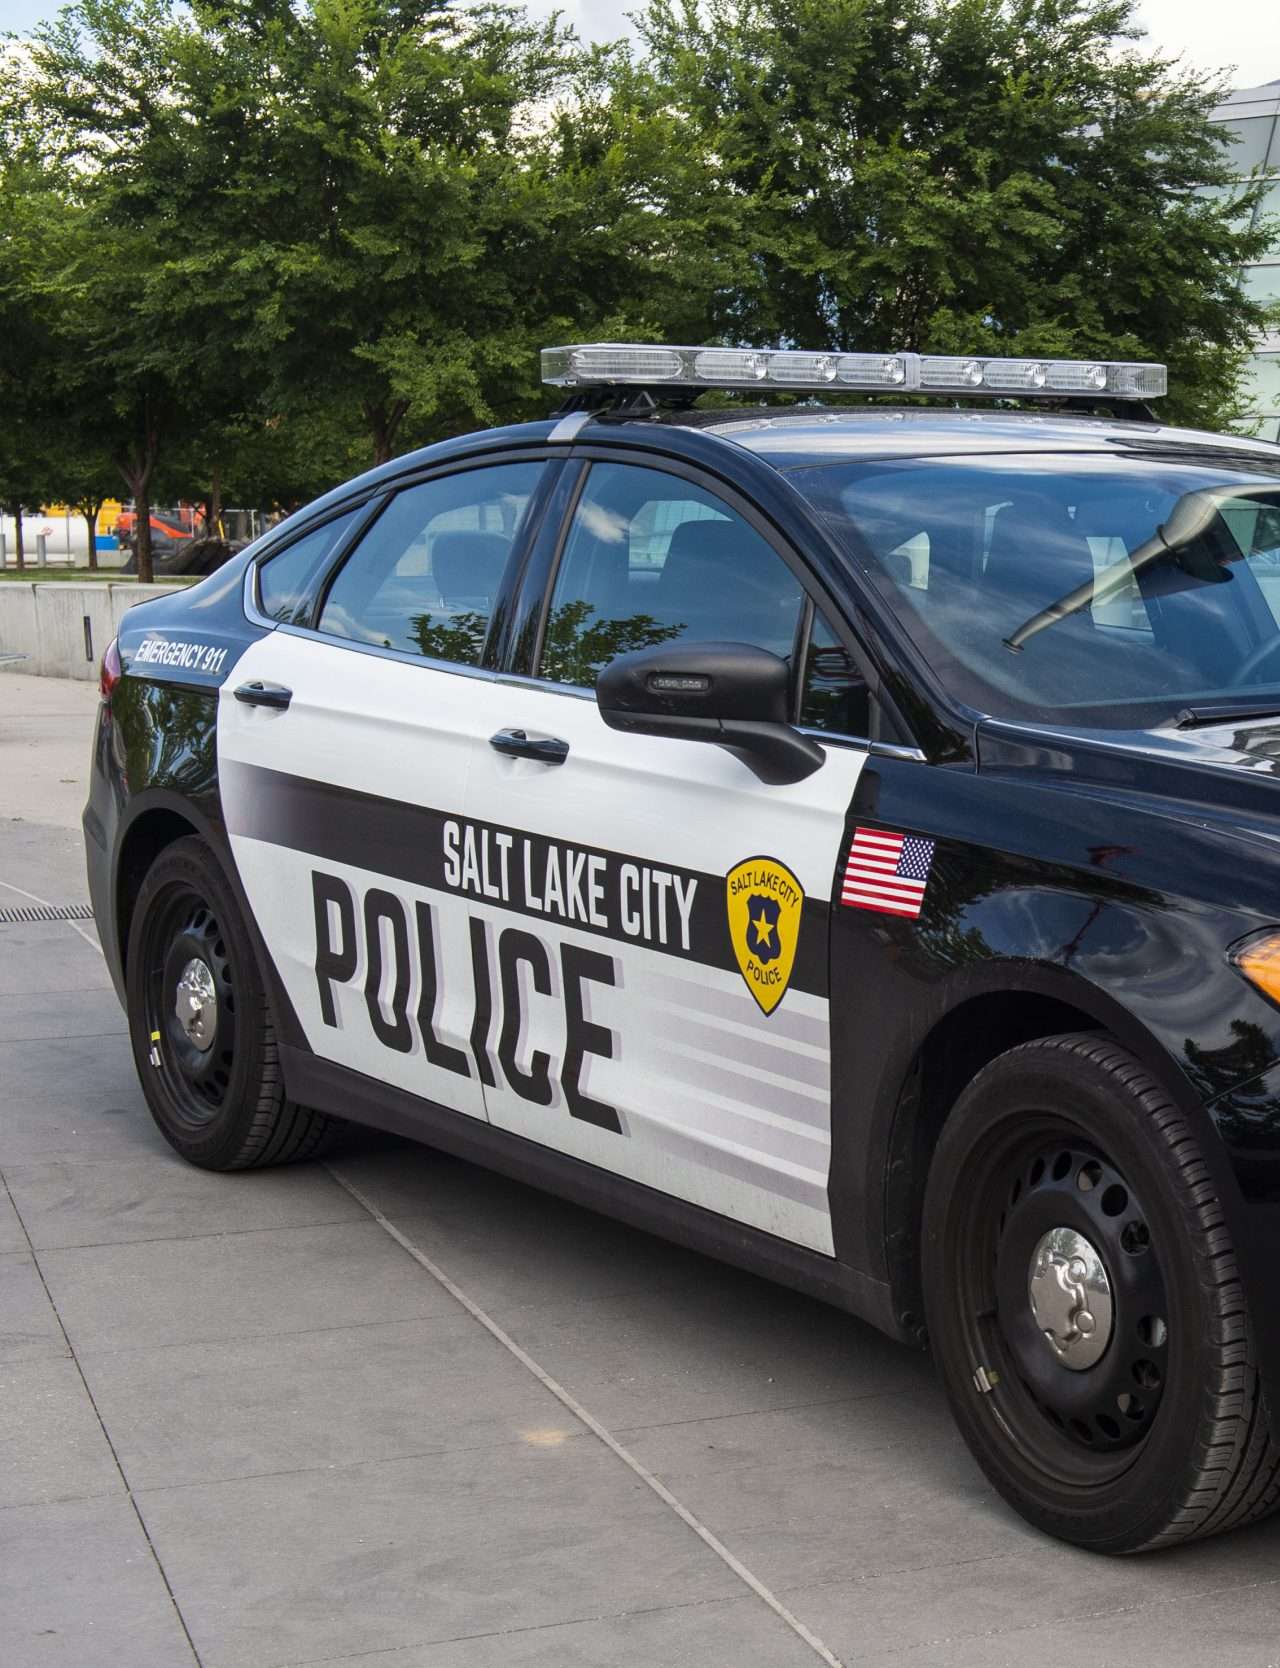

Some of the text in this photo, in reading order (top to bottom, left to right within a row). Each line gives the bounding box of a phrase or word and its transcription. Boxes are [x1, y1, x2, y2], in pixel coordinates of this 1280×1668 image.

[134, 640, 228, 672] EMERGENCY 911
[443, 820, 698, 950] SALT LAKE CITY
[730, 869, 800, 908] SALT LAKE CITY
[747, 959, 782, 986] POLICE
[311, 869, 627, 1137] POLICE
